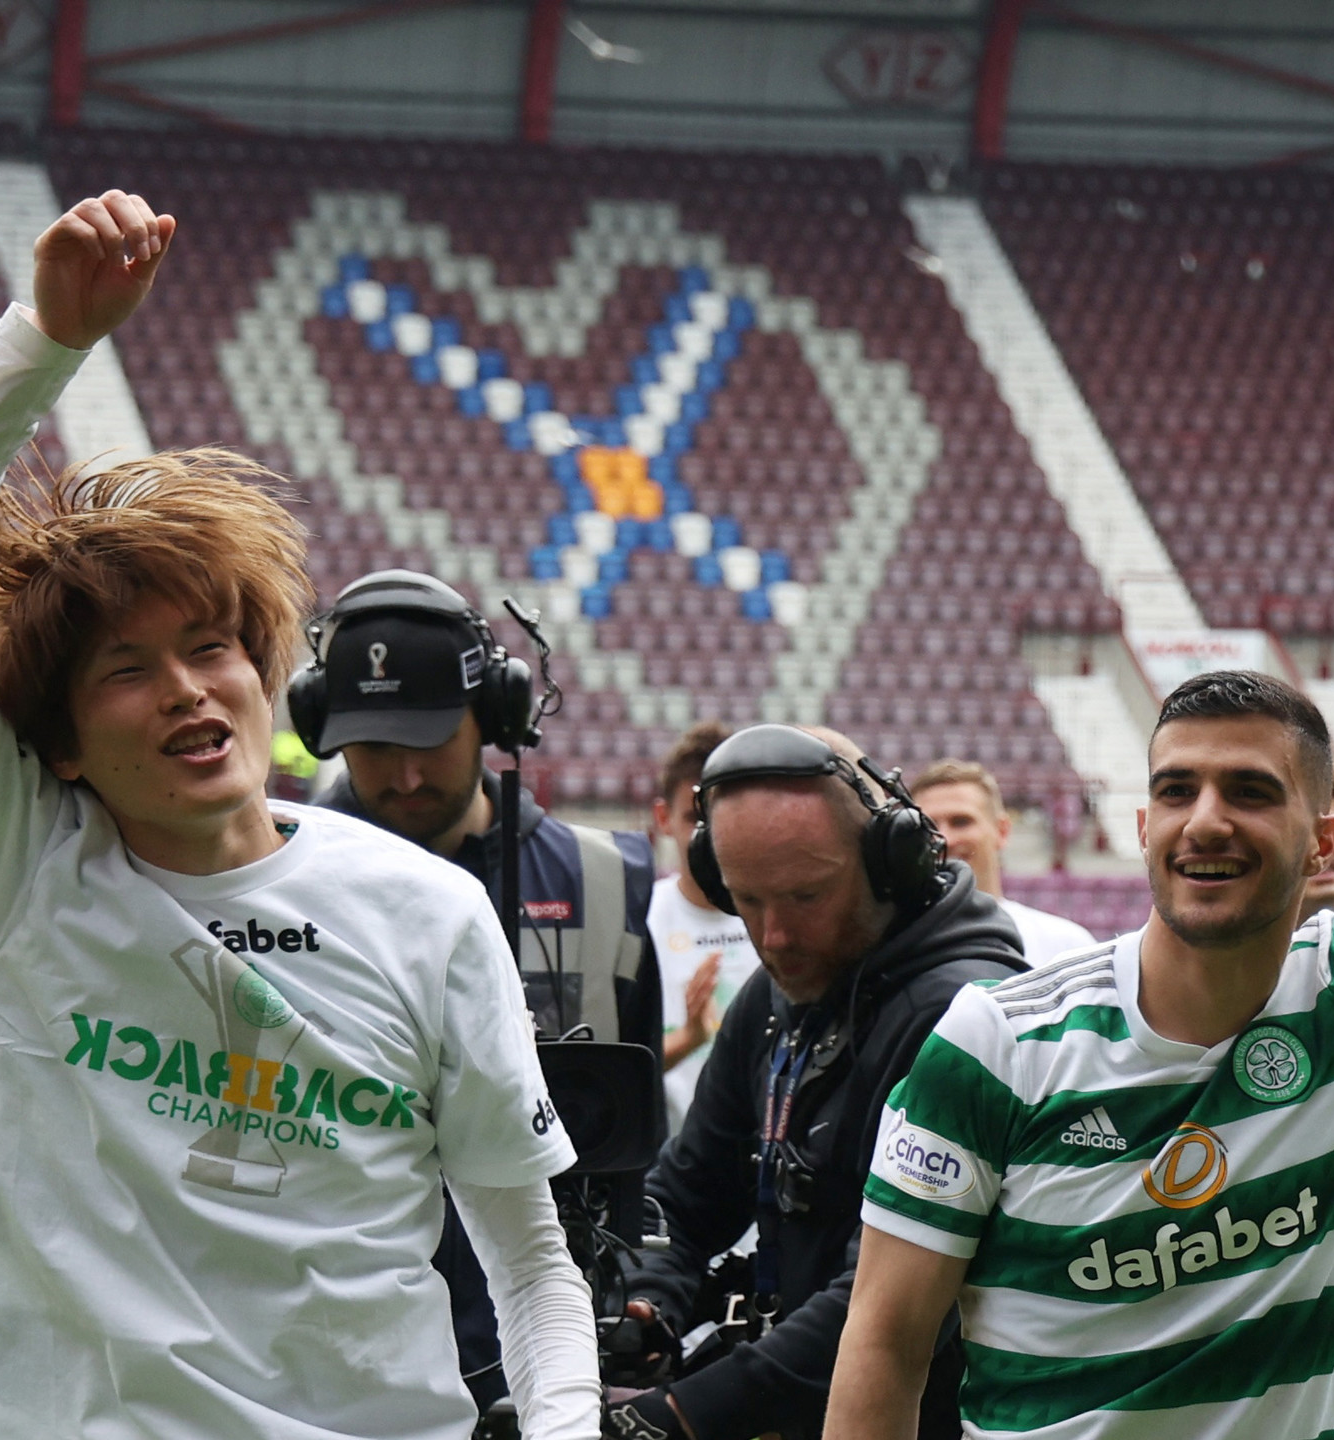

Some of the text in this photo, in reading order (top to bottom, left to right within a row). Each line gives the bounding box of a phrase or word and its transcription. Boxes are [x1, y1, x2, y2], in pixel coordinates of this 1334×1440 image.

[147, 1092, 340, 1150] CHAMPIONS
[896, 1133, 961, 1180] cinch
[1060, 1129, 1128, 1151] adidas
[897, 1162, 950, 1189] PREMIERSHIP
[900, 1174, 938, 1194] CHAMPIONS
[1067, 1186, 1318, 1292] dafabet
